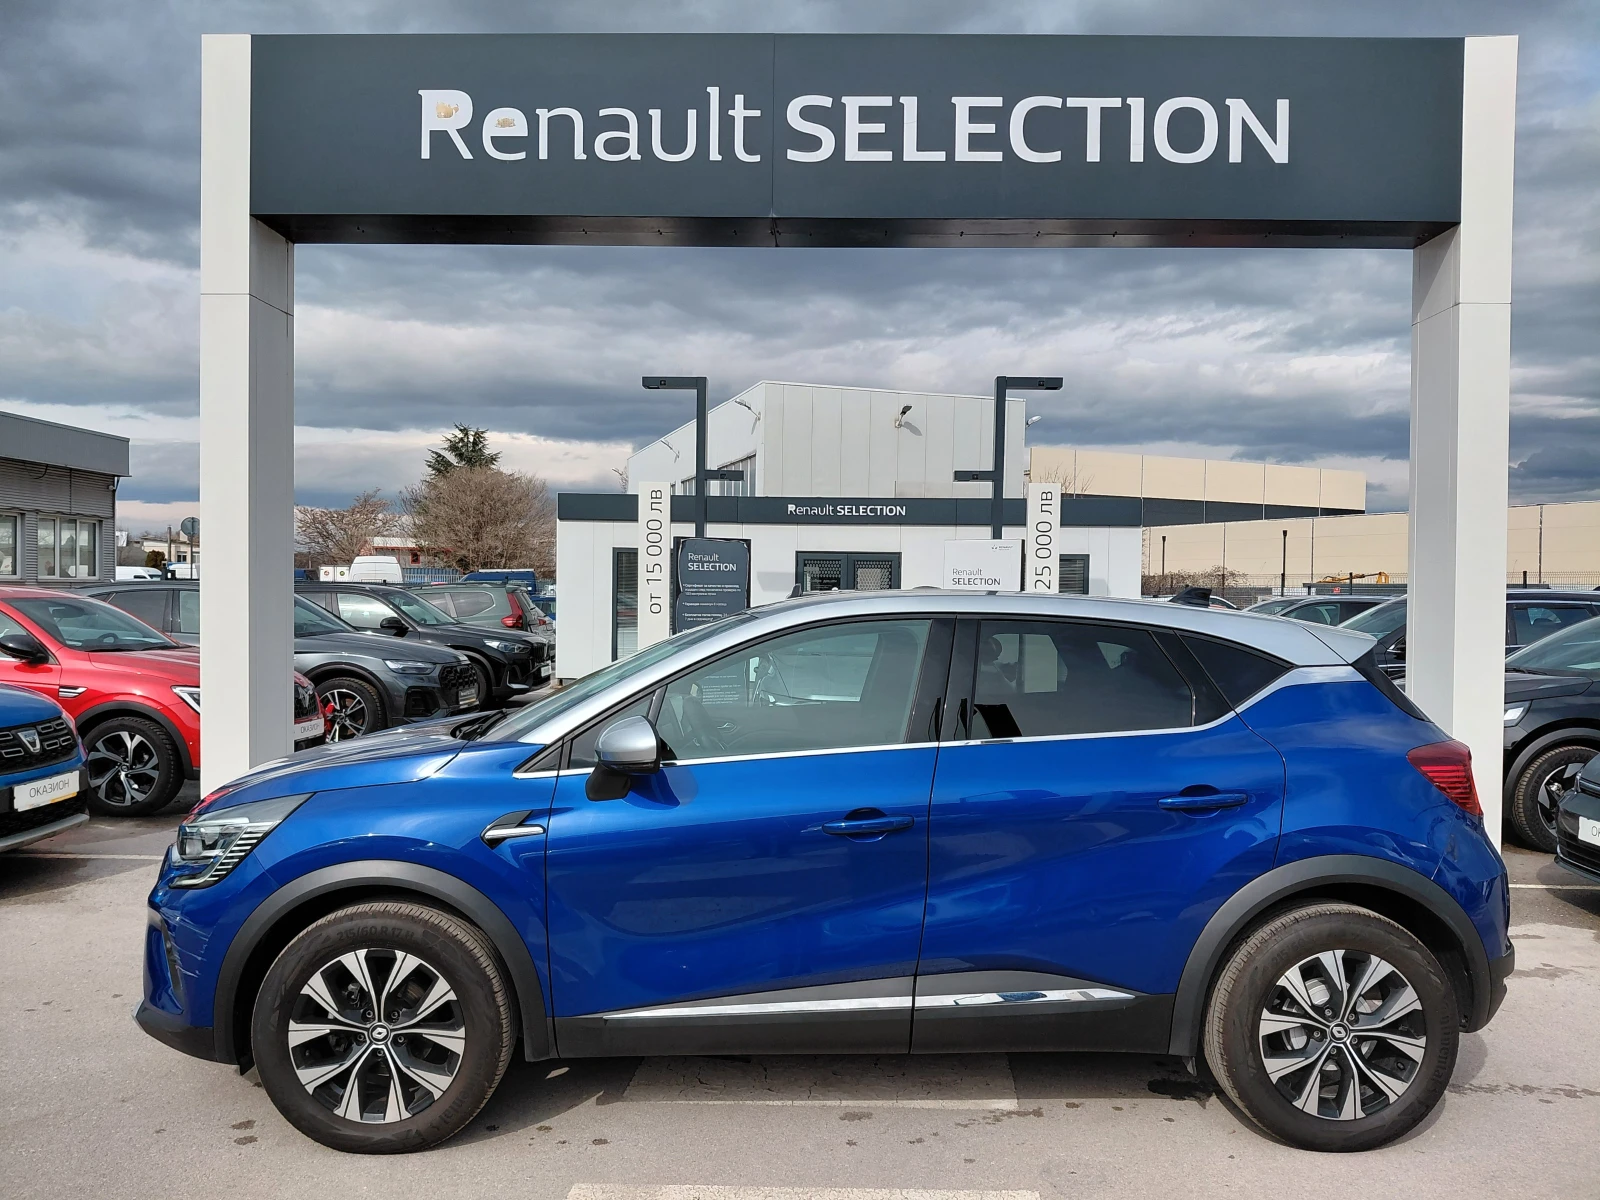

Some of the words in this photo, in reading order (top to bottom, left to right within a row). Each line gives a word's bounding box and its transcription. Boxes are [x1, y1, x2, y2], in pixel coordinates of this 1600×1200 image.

[418, 86, 762, 163] Renault
[786, 94, 1290, 164] SELECTION
[787, 503, 834, 516] Renault
[837, 505, 906, 516] SELECTION
[646, 519, 663, 557] 000
[1035, 520, 1053, 560] 000
[687, 562, 737, 572] SELECTION
[688, 553, 720, 562] Renault
[646, 563, 663, 586] 15
[952, 568, 982, 576] Renault
[952, 577, 1001, 586] SELECTION
[1034, 565, 1052, 590] 25
[29, 778, 70, 798] ОКАЗИОН
